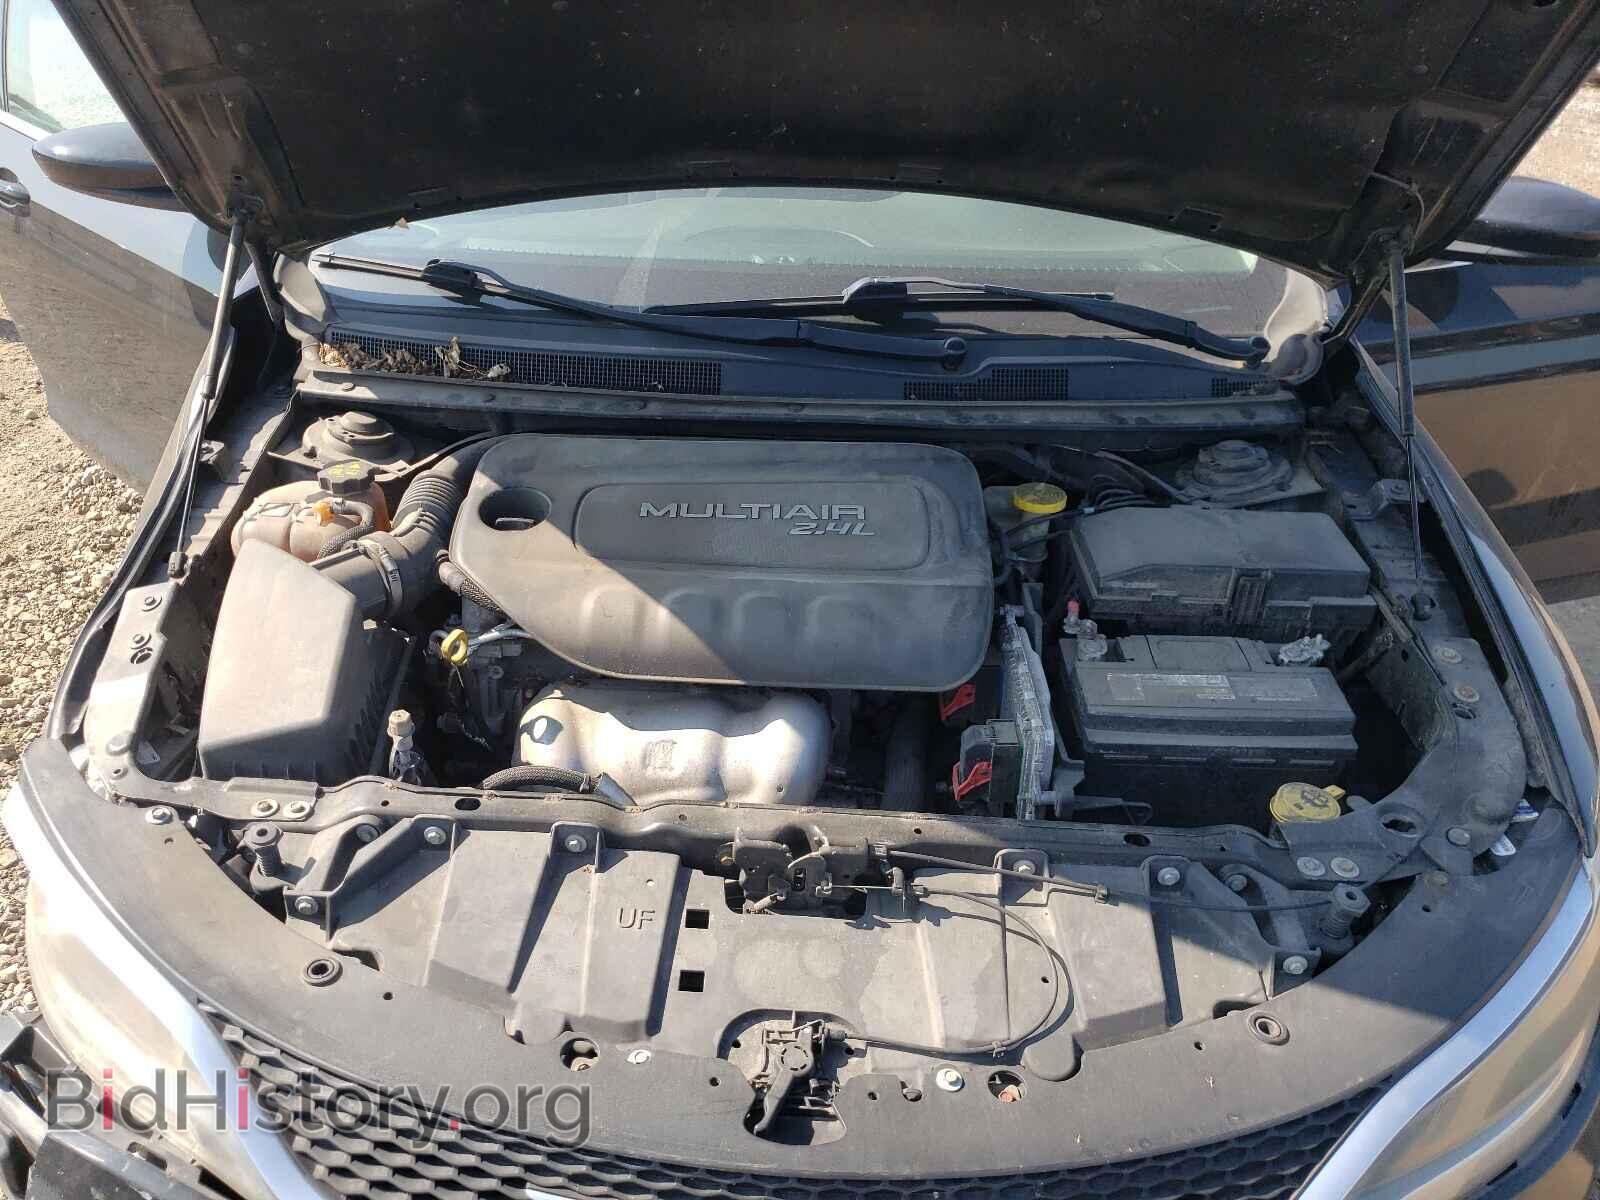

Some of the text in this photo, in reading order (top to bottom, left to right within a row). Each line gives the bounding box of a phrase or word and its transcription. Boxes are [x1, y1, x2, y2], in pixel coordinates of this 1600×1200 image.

[639, 502, 866, 521] MULTIAIR
[787, 521, 876, 536] 2.4L
[618, 907, 656, 930] UF
